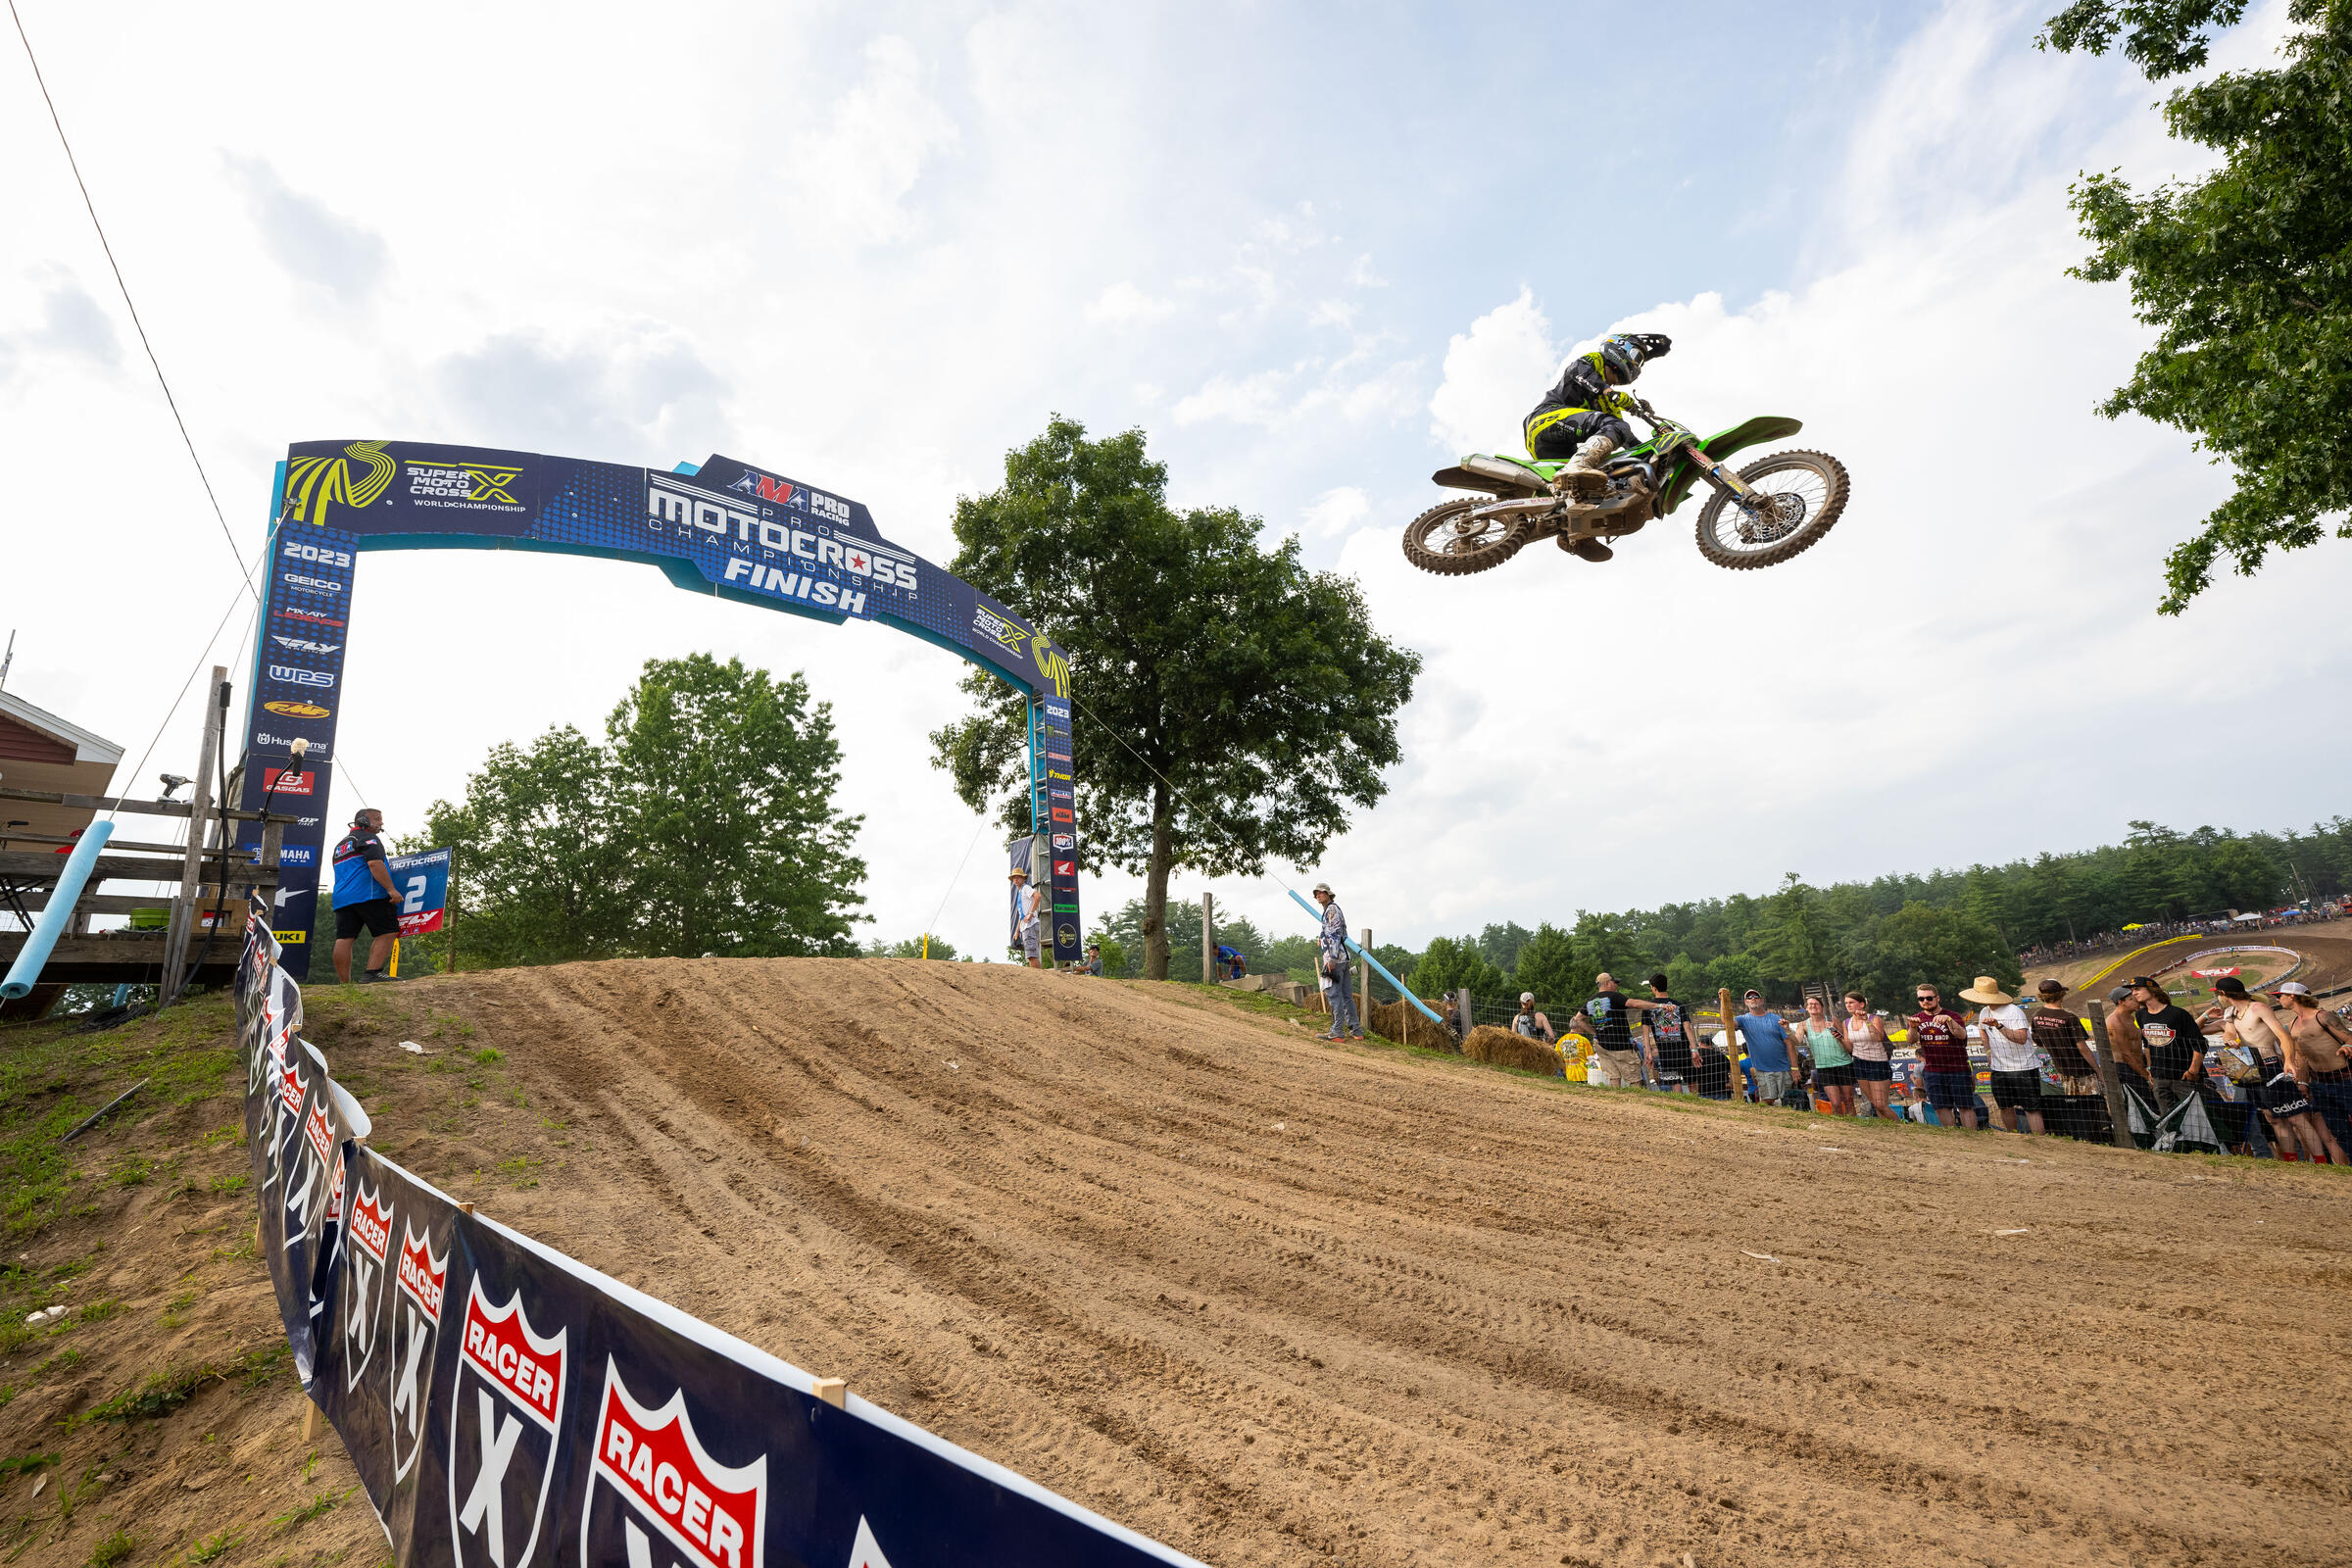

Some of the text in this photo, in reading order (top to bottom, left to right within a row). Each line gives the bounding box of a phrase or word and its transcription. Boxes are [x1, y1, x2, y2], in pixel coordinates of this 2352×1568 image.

[407, 467, 470, 480] SUPER
[413, 476, 469, 489] MOTO
[410, 485, 471, 498] CROSS
[726, 468, 809, 513] AMA
[414, 499, 526, 513] WORLD CHAMPIONSHIP
[810, 491, 851, 519] PRO
[810, 507, 851, 527] RACING
[649, 487, 917, 591] MOTOCROSS
[284, 541, 351, 568] 2023
[649, 518, 918, 602] CHAMPIONSHIP
[284, 573, 342, 592] GEICO
[290, 585, 333, 598] MOTORCYCLE
[723, 557, 866, 614] FINISH
[274, 610, 345, 627] LEGENDS
[270, 634, 341, 654] FLY
[269, 664, 335, 687] WPS
[1047, 705, 1069, 719] 2023
[270, 736, 328, 750] Husrna
[1054, 772, 1071, 781] THOR
[280, 849, 311, 859] MAHA
[403, 875, 427, 914] 2
[309, 1114, 330, 1159] RACER
[287, 1147, 319, 1227] X
[353, 1207, 386, 1253] RACER
[401, 1252, 441, 1316] RACER
[348, 1250, 373, 1355] X
[395, 1302, 428, 1441] X
[467, 1319, 554, 1411] RACER
[459, 1387, 523, 1568] X
[607, 1419, 744, 1568] RACER
